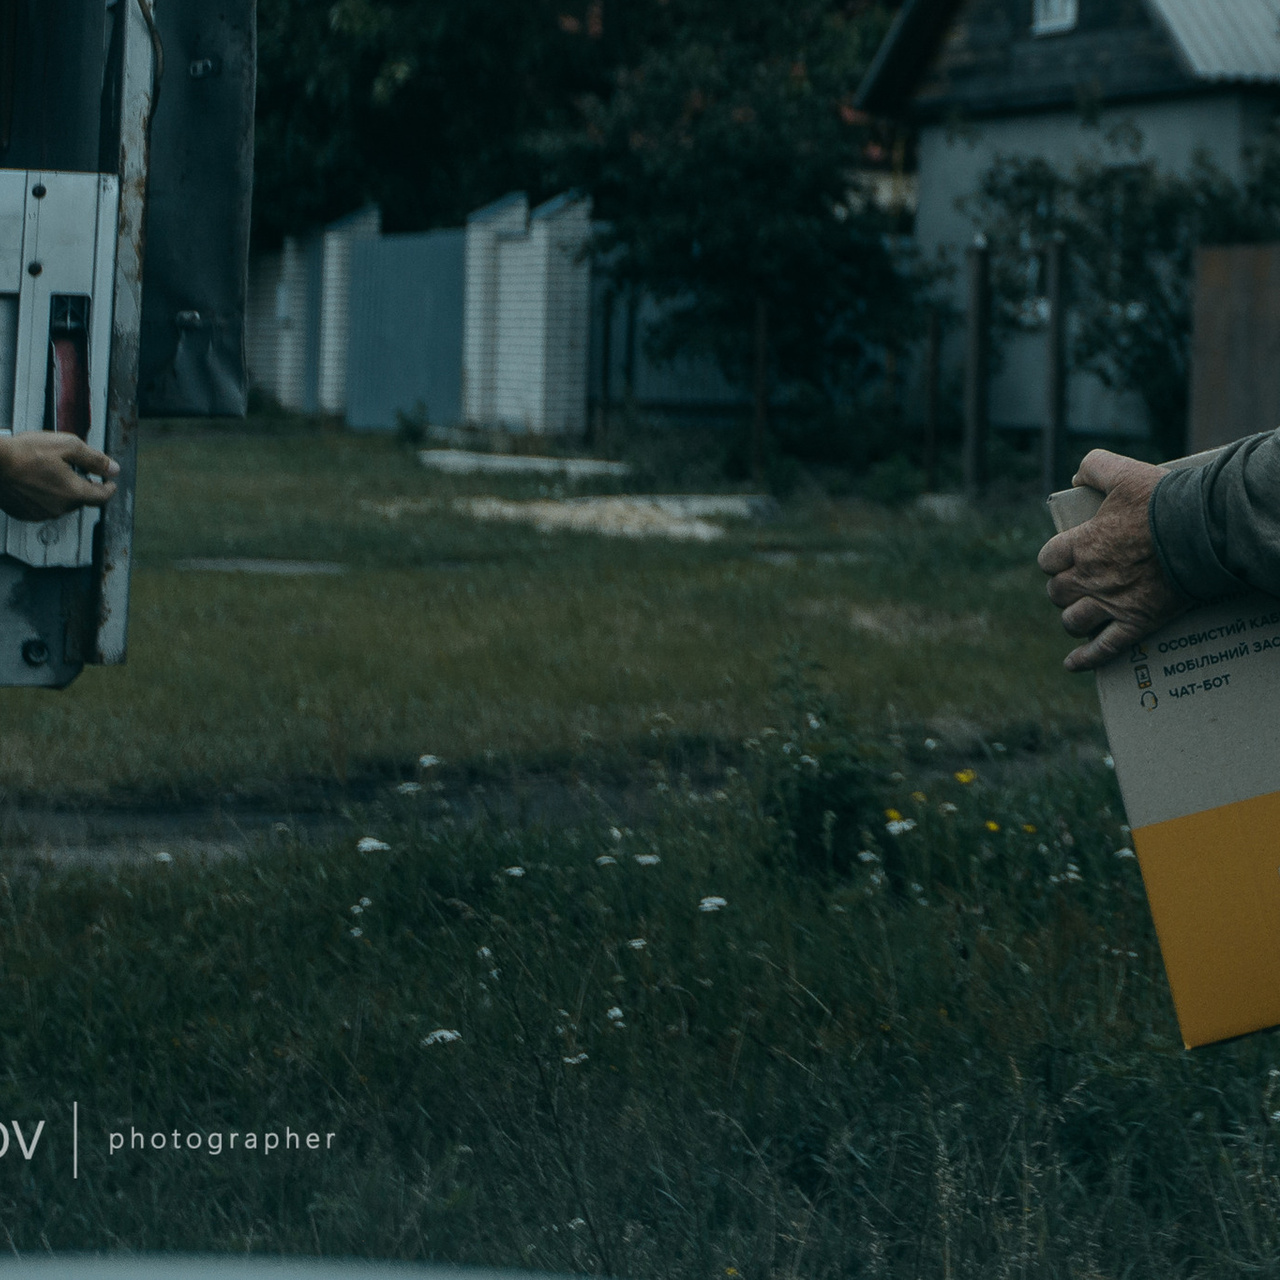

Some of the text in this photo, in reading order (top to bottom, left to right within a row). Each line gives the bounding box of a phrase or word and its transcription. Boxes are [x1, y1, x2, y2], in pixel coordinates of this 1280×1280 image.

[1158, 618, 1248, 654] ОСОБИСТИЙ
[1163, 641, 1250, 677] МОБІЛЬНИЙ
[1168, 673, 1232, 699] ЧАТ-БОТ
